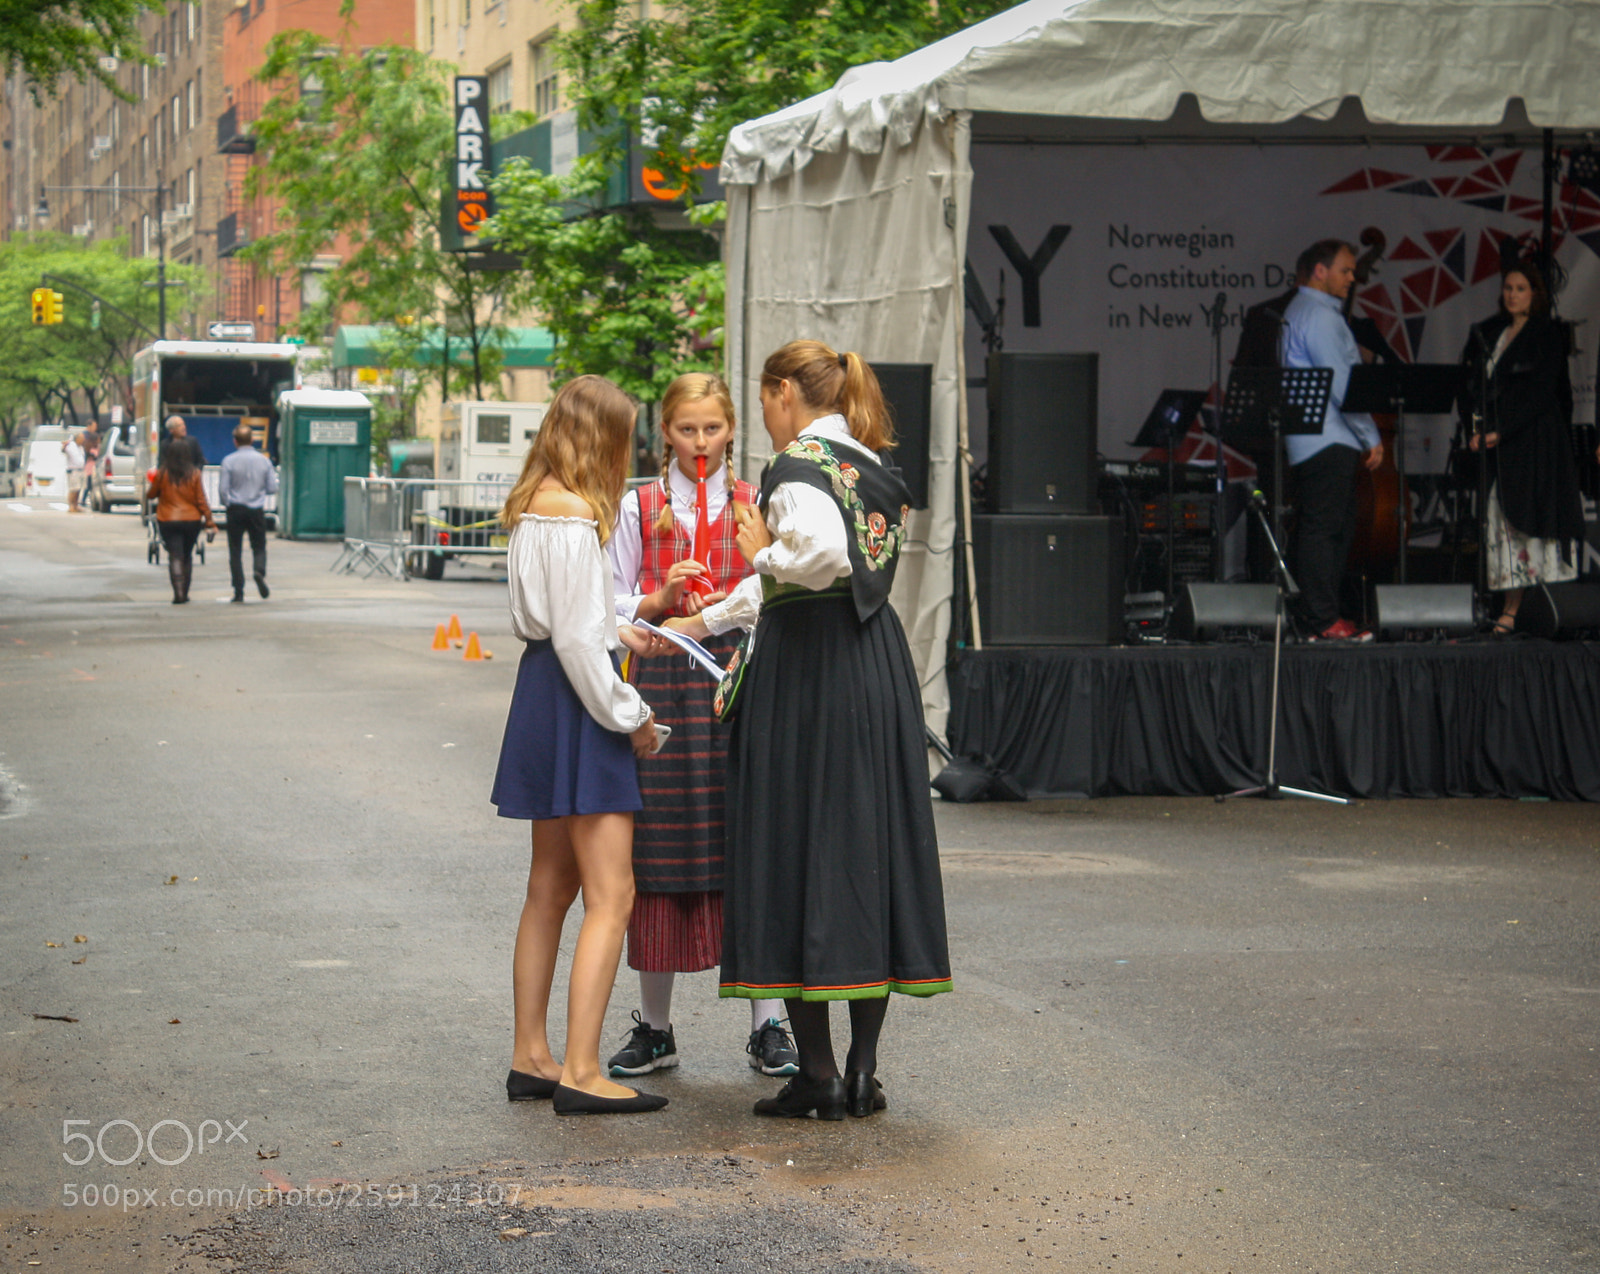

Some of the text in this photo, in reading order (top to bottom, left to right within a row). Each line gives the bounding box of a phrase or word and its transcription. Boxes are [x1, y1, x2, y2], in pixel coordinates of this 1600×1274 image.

[457, 79, 484, 189] PARK
[457, 190, 487, 200] icon
[1108, 224, 1234, 257] Norwegian
[1108, 264, 1298, 289] Constitution Da
[1109, 305, 1130, 328] in
[1139, 305, 1192, 328] New
